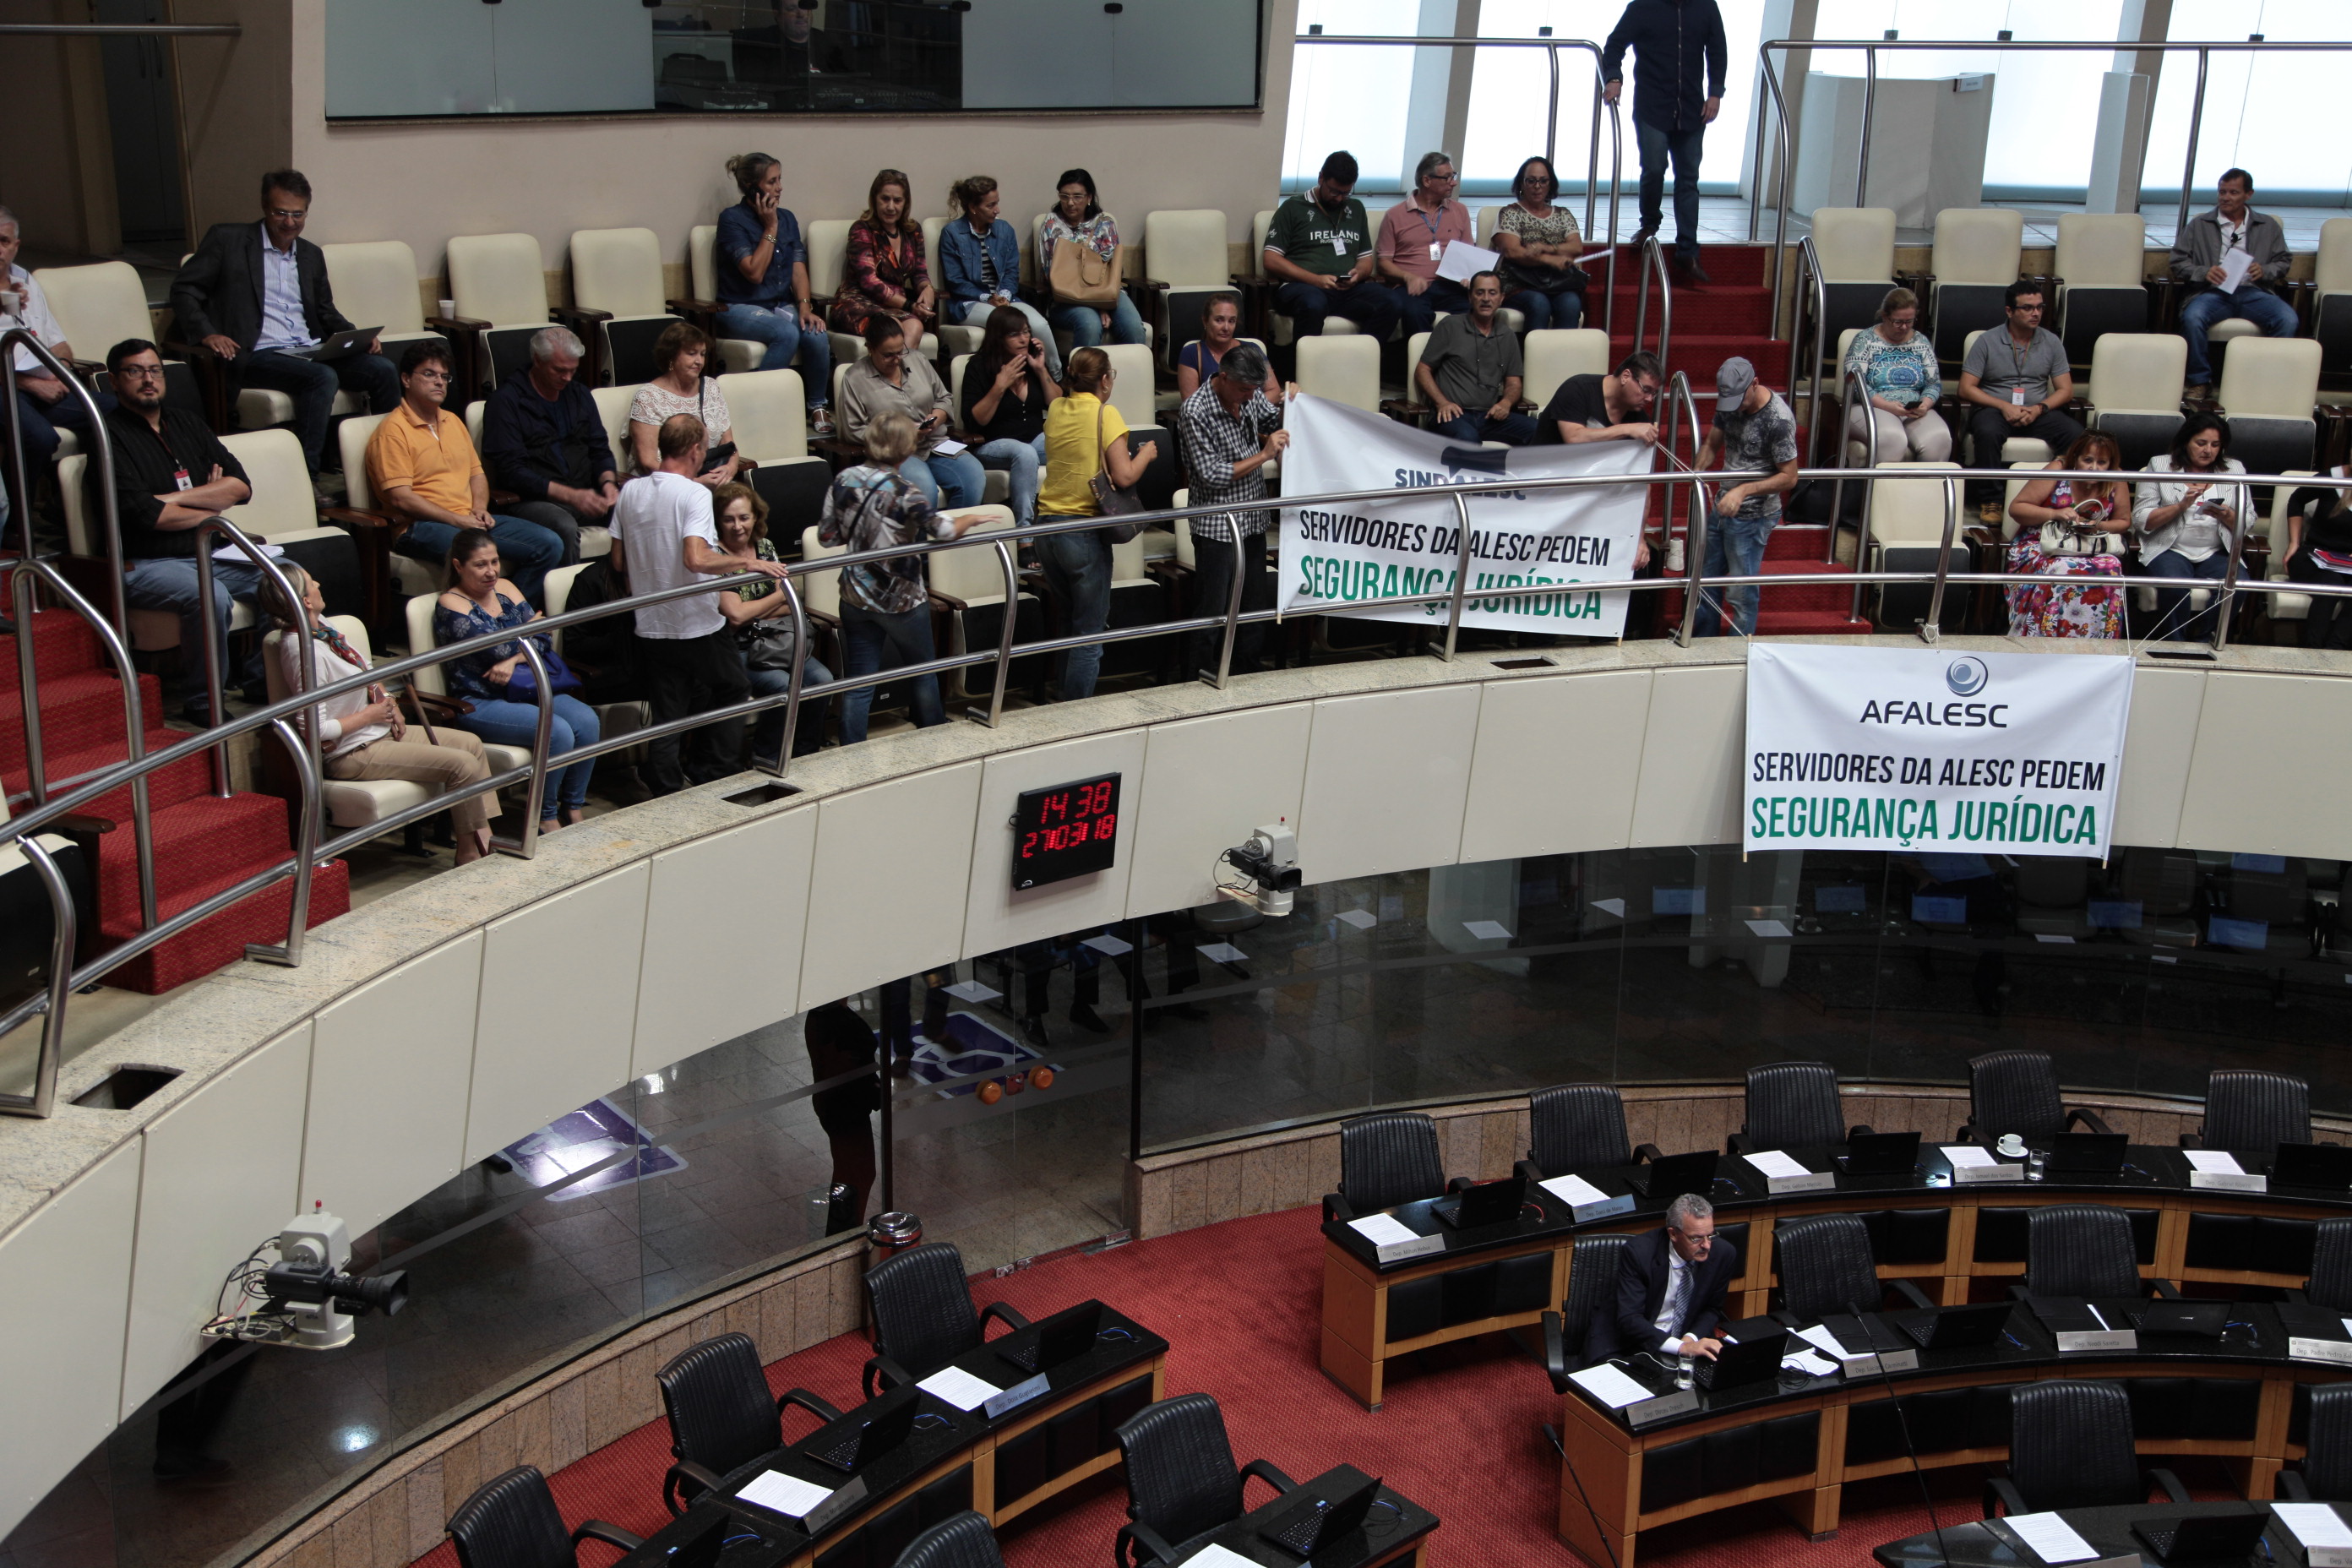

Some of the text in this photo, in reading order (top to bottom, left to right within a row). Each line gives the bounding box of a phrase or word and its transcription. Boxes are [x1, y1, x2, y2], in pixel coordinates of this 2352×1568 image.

[1309, 230, 1360, 242] IRELAND
[1300, 509, 1610, 567] SERVIDORES DA ALESC PEDEM
[1468, 568, 1602, 620] JURÍDICA
[1859, 700, 2009, 728] AFALESC
[1752, 752, 2105, 791] SERVIDORES DA ALESC PEDEM
[1751, 794, 2096, 847] SEGURANÇA JURÍDICA
